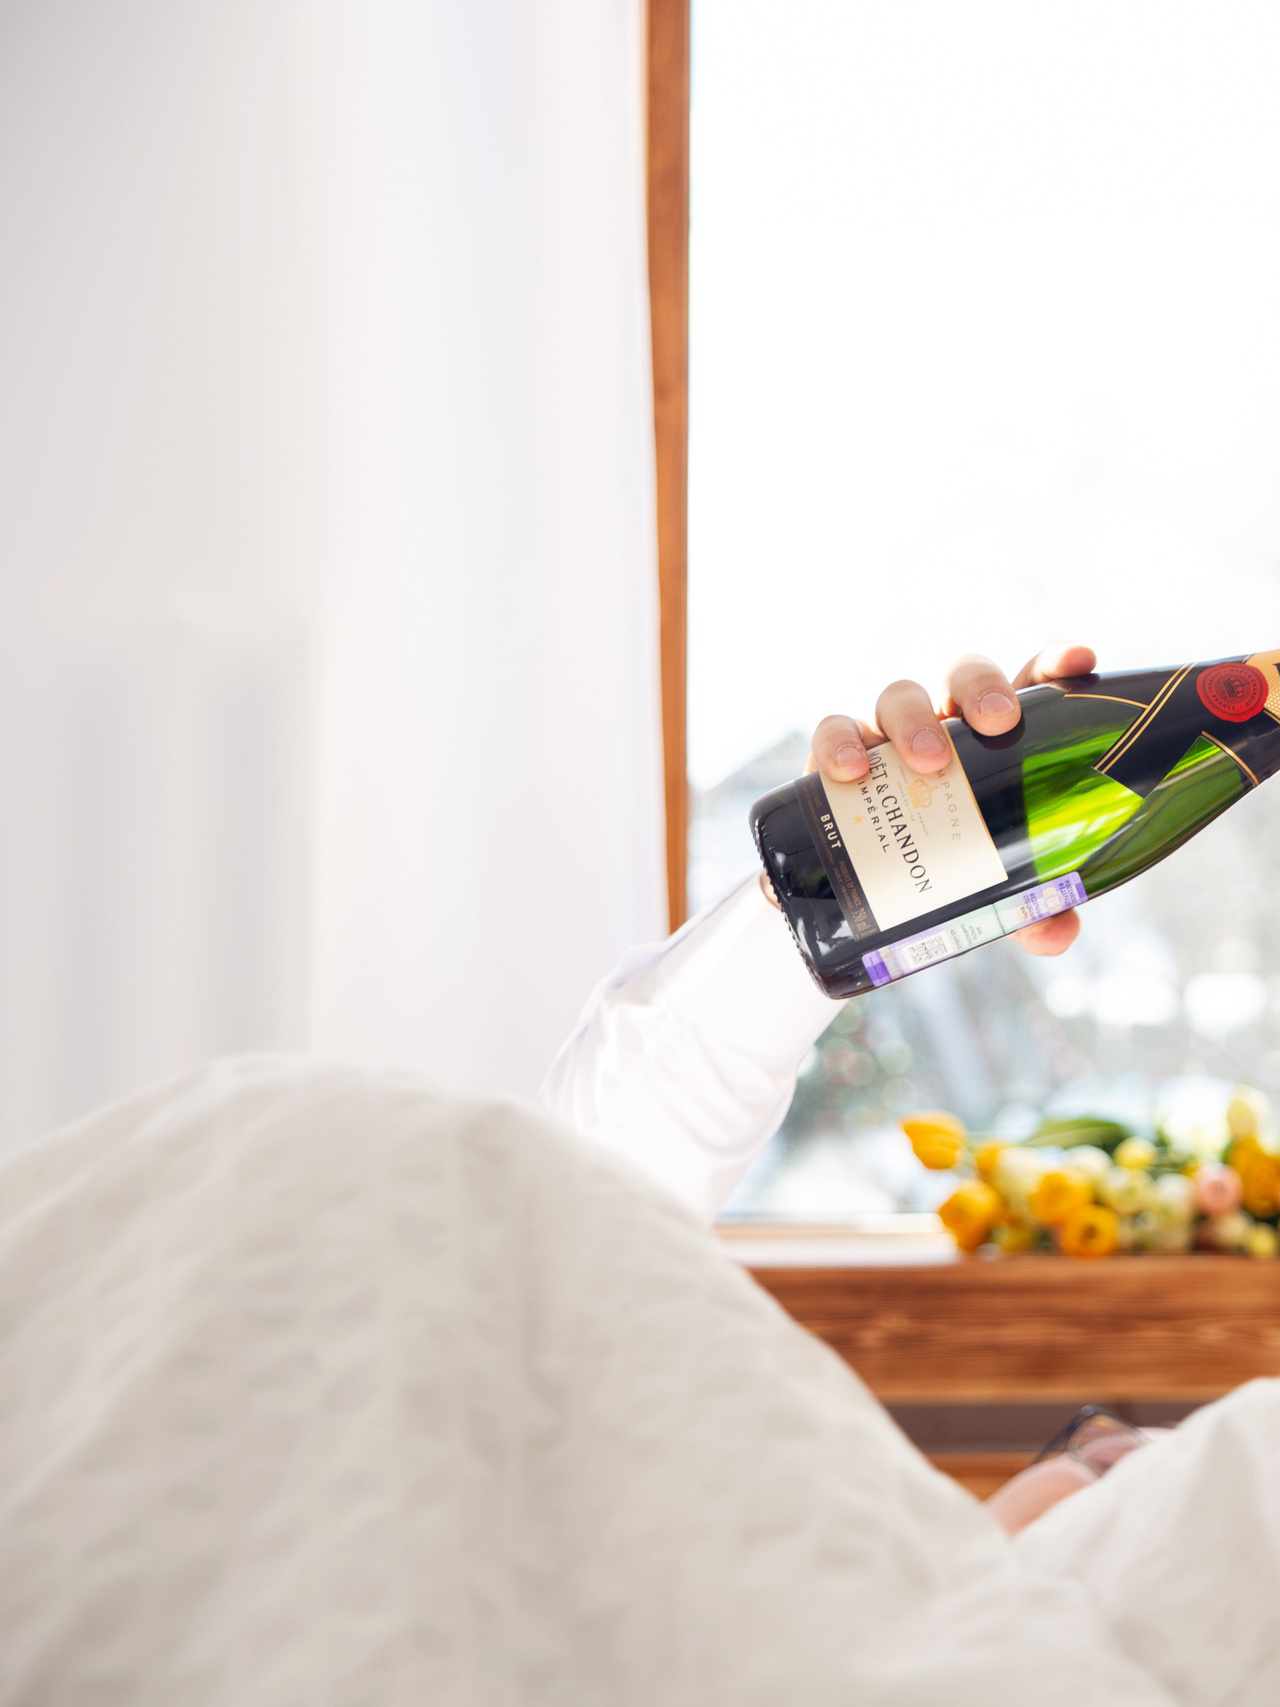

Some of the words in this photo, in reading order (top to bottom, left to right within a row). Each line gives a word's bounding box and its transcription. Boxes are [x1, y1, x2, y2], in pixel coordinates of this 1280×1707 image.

[868, 749, 889, 785] MOËT
[876, 783, 889, 794] &
[820, 813, 842, 849] BRUT
[858, 780, 889, 853] IMPÉRIAL
[935, 769, 962, 842] MPAGNE
[881, 795, 933, 893] CHANDON
